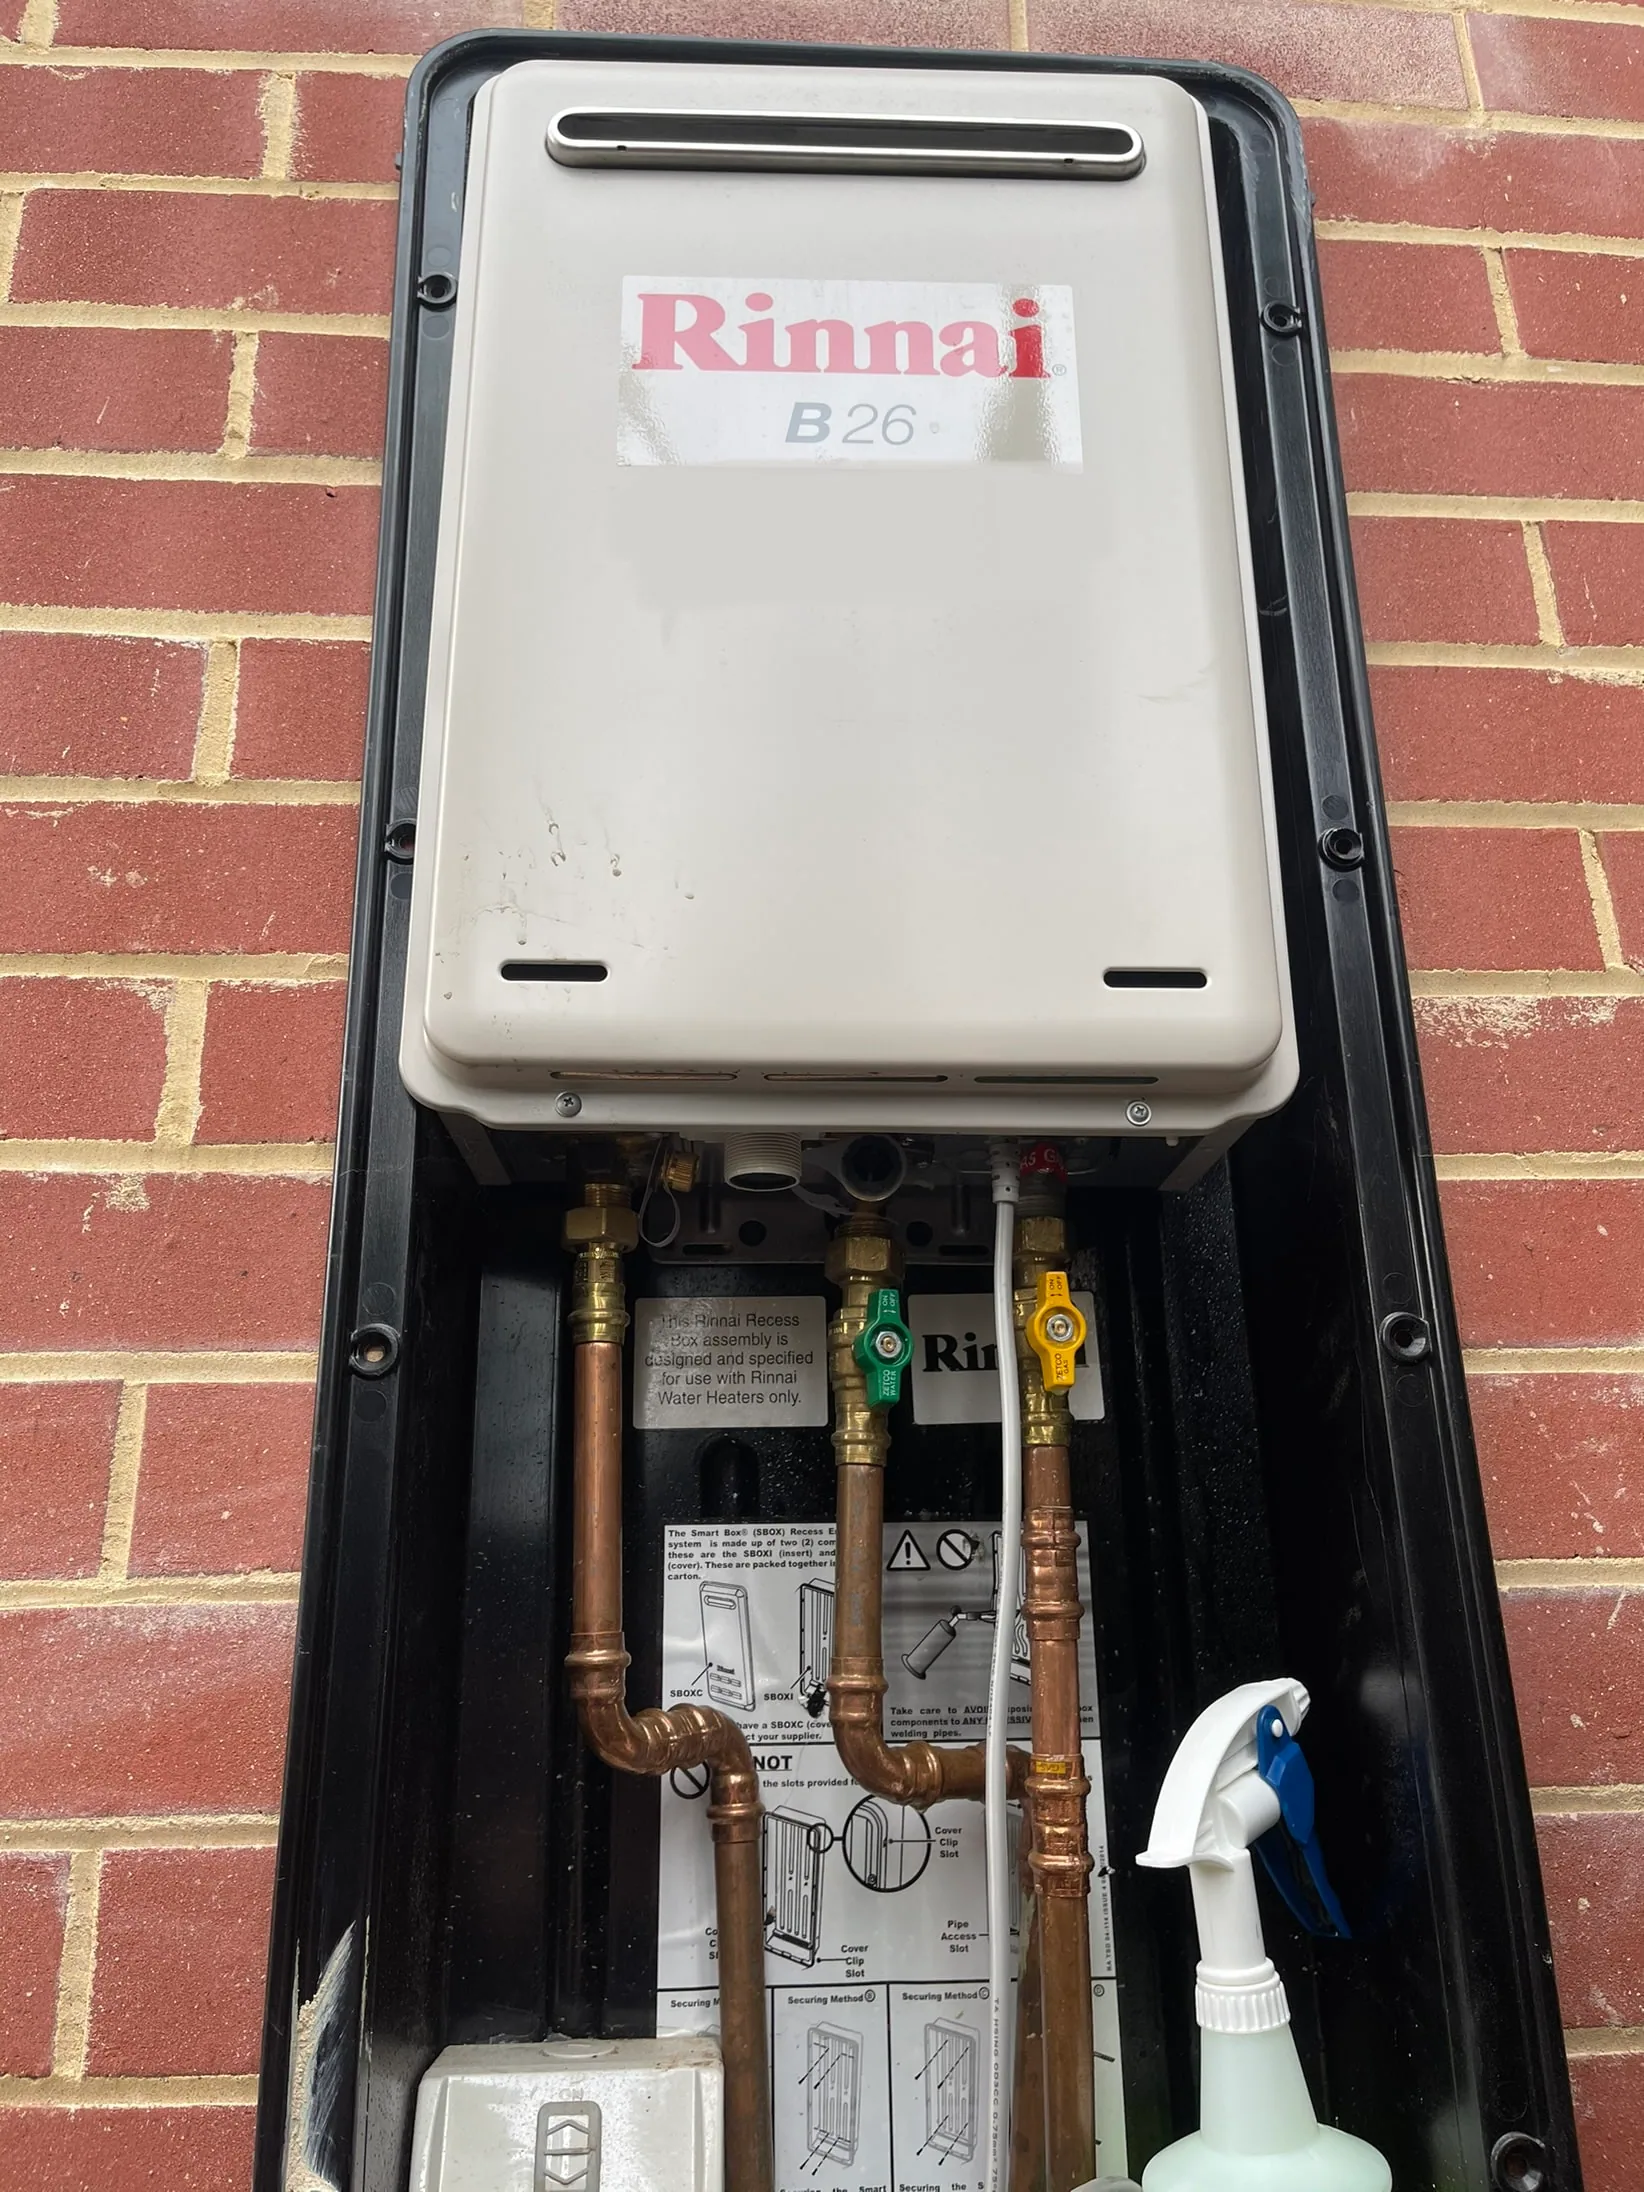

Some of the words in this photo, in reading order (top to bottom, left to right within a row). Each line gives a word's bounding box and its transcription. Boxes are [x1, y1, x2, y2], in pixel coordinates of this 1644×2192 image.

[662, 1313, 689, 1328] This
[695, 1313, 740, 1328] Rinnai
[746, 1313, 800, 1327] Recess
[671, 1334, 698, 1347] Box
[703, 1333, 772, 1348] assembly
[777, 1332, 788, 1345] is
[645, 1352, 712, 1369] designed
[717, 1351, 744, 1365] and
[748, 1350, 813, 1367] specified
[662, 1371, 680, 1386] for
[685, 1373, 712, 1385] use
[716, 1371, 746, 1384] with
[751, 1370, 797, 1384] Rinnai
[882, 1369, 891, 1396] ZETCO
[658, 1391, 702, 1405] Water
[706, 1390, 765, 1405] Heaters
[768, 1390, 802, 1406] only.
[691, 1529, 720, 1538] Smart
[753, 1528, 785, 1537] (SBOX)
[790, 1528, 823, 1536] Recess
[668, 1541, 702, 1549] system
[710, 1540, 718, 1548] is
[722, 1539, 748, 1548] made
[751, 1540, 763, 1549] up
[767, 1539, 776, 1547] of
[801, 1539, 814, 1548] (2)
[668, 1551, 694, 1559] these
[743, 1550, 773, 1558] SBOXI
[779, 1549, 813, 1559] (insert)
[819, 1549, 836, 1557] and
[668, 1561, 703, 1571] (cover).
[705, 1561, 734, 1569] These
[752, 1561, 786, 1570] packed
[788, 1560, 827, 1569] together
[670, 1689, 703, 1698] SBOXC
[764, 1693, 794, 1701] SBOXI
[891, 1706, 913, 1715] Take
[920, 1707, 941, 1715] care
[737, 1721, 759, 1729] have
[771, 1721, 803, 1729] SBOXC
[891, 1718, 948, 1727] components
[950, 1717, 960, 1725] to
[962, 1716, 984, 1726] ANY
[758, 1734, 779, 1743] your
[782, 1732, 822, 1741] supplier.
[891, 1729, 928, 1738] welding
[933, 1729, 961, 1738] pipes.
[753, 1755, 793, 1771] NOT
[763, 1780, 779, 1788] the
[781, 1779, 804, 1788] slots
[807, 1778, 849, 1789] provided
[935, 1826, 962, 1835] Cover
[940, 1838, 958, 1847] Clip
[939, 1850, 959, 1858] Slot
[947, 1919, 969, 1930] Pipe
[941, 1932, 977, 1941] Access
[841, 1944, 868, 1953] Cover
[949, 1944, 969, 1953] Slot
[845, 1956, 864, 1966] Clip
[845, 1969, 865, 1978] Slot
[788, 1994, 829, 2006] Securing
[830, 1993, 864, 2003] Method
[902, 1991, 942, 2002] Securing
[945, 1990, 978, 2000] Method
[670, 1997, 711, 2009] Securing
[993, 1998, 1000, 2013] TA
[899, 2182, 941, 2192] Securing
[951, 2182, 967, 2191] the
